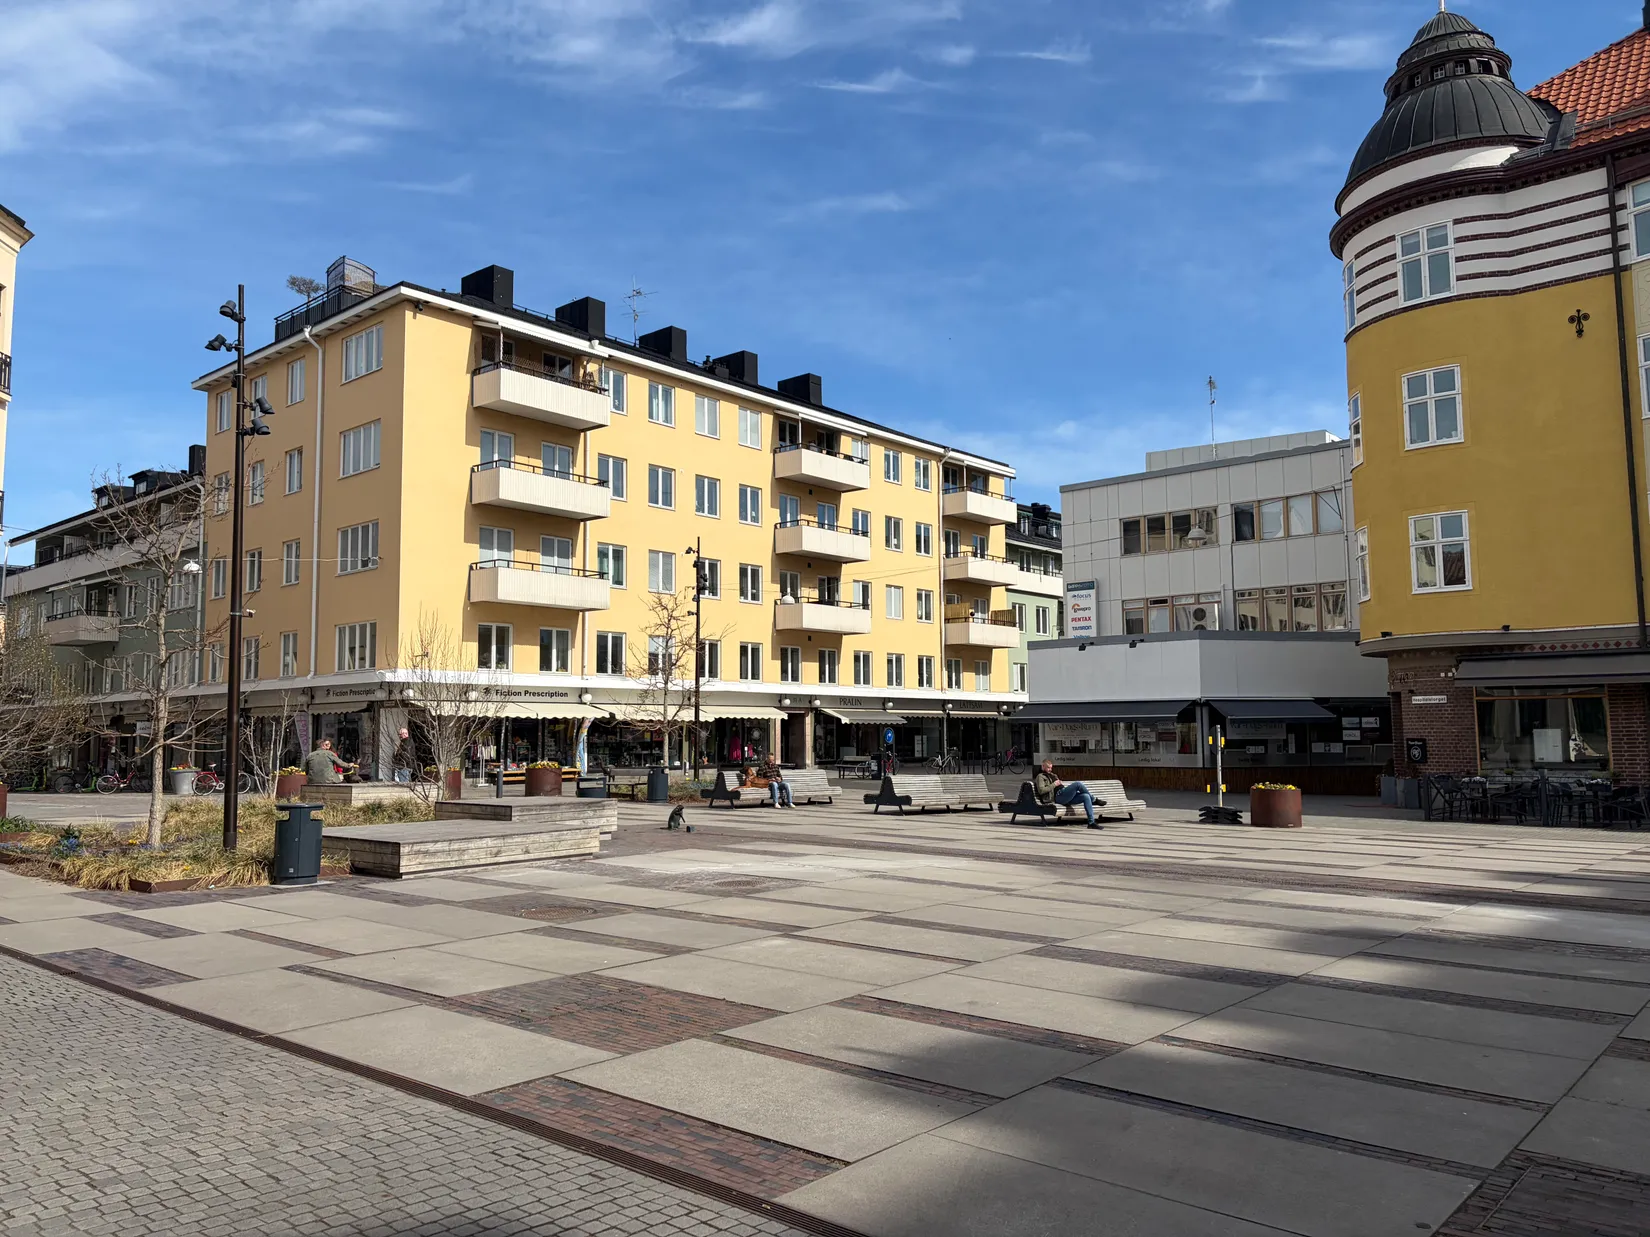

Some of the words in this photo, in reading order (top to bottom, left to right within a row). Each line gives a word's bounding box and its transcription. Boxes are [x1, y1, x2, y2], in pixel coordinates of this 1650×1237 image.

[332, 689, 348, 697] Fiction
[349, 688, 376, 696] Prescriptio
[495, 689, 522, 697] Fiction
[524, 690, 569, 698] Prescription
[839, 697, 862, 706] PRALIN
